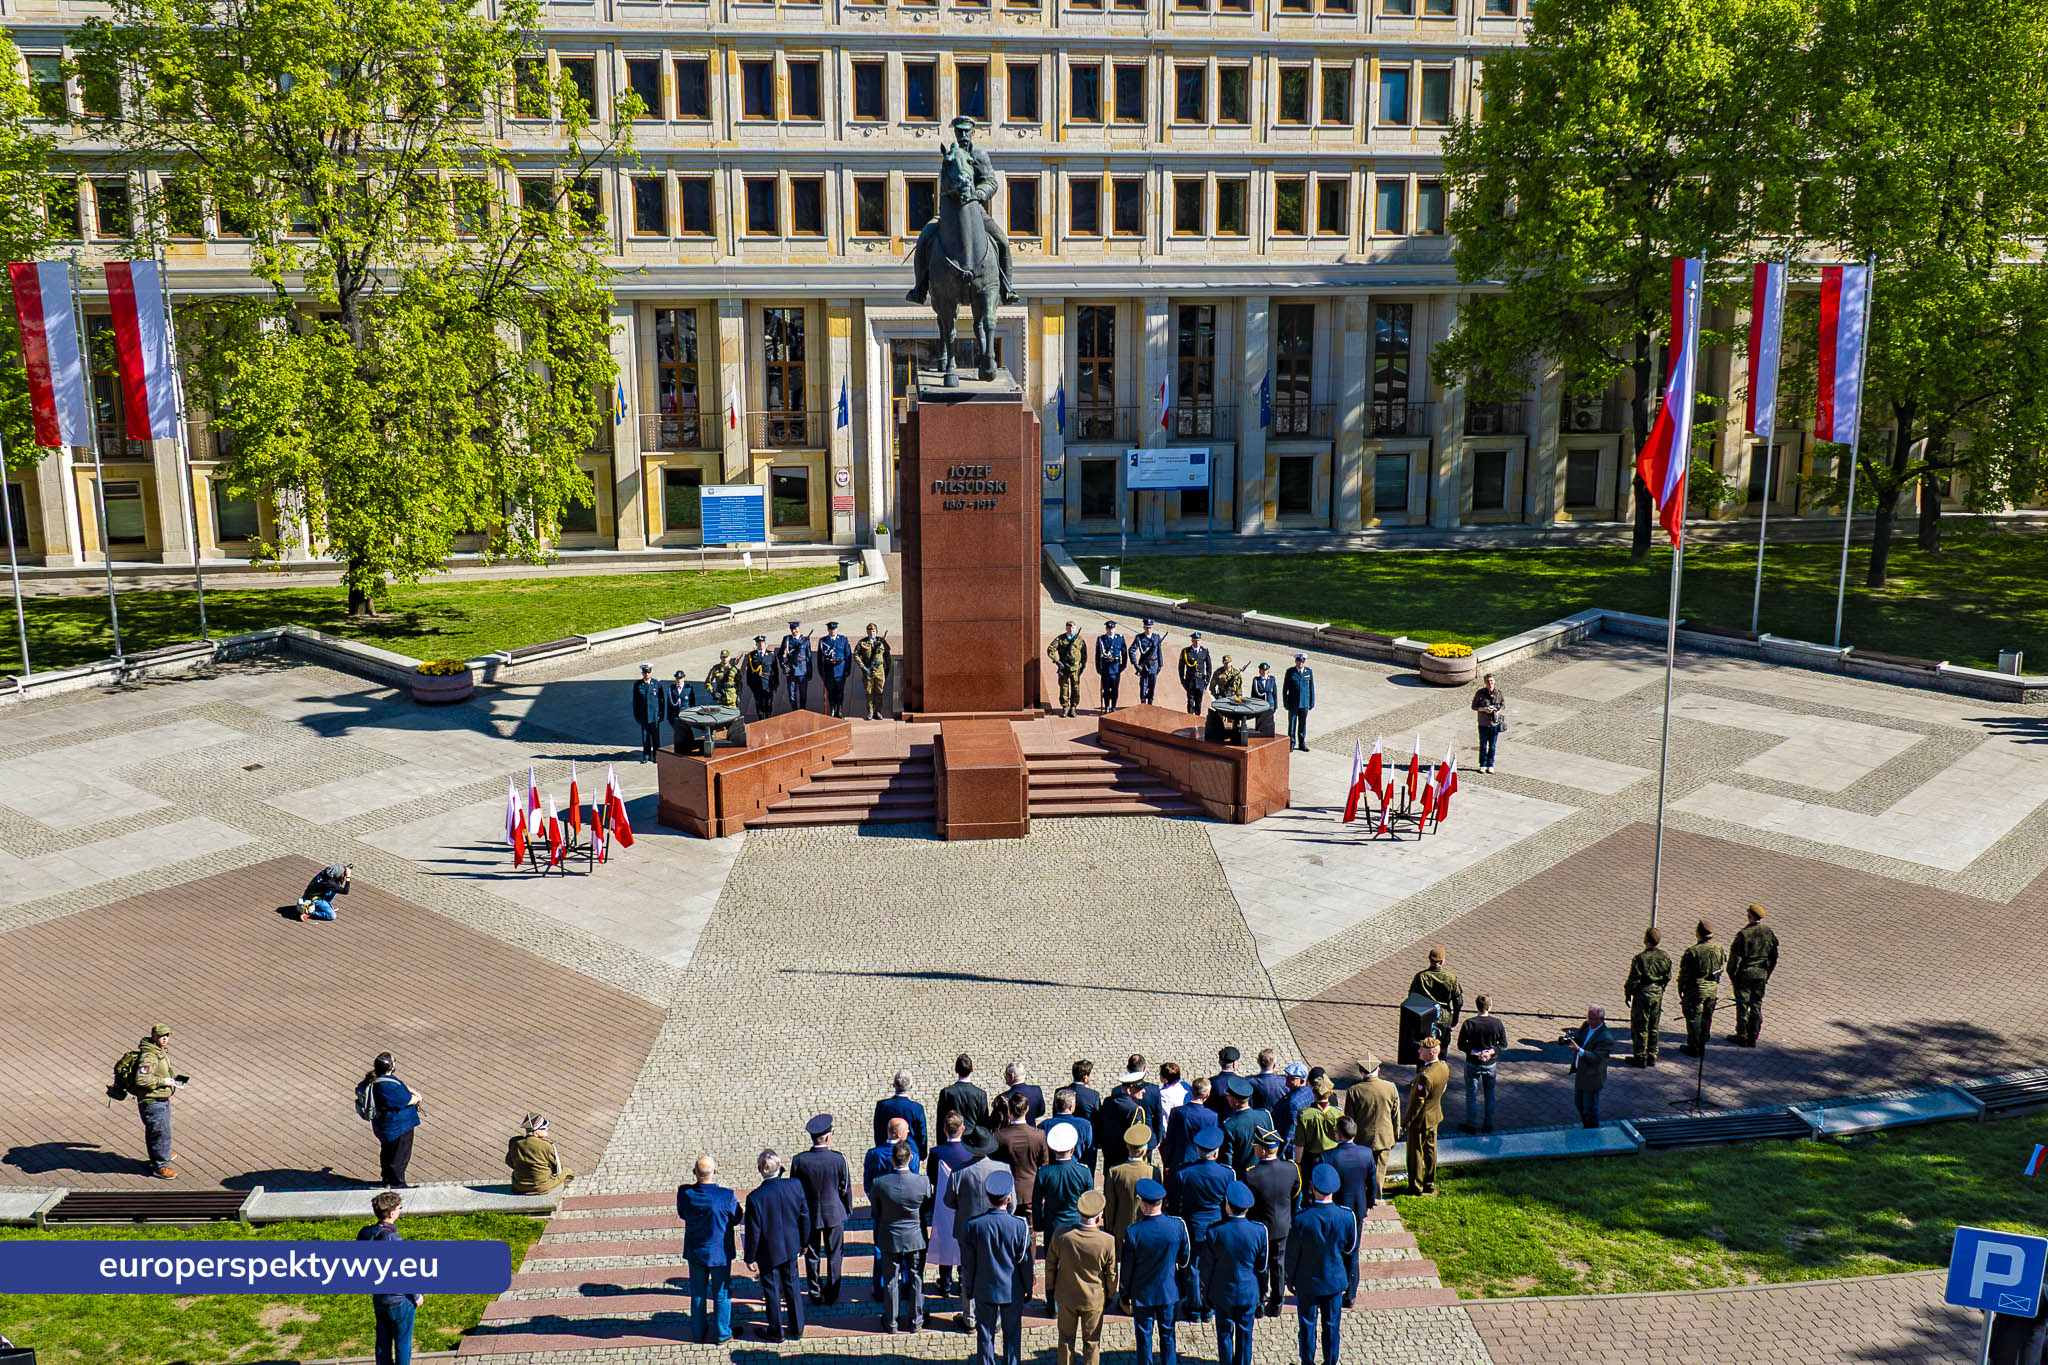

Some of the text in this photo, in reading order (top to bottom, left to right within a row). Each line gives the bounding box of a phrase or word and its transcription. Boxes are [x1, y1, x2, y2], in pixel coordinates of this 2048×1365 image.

[949, 462, 993, 478] JÓZEF
[934, 480, 1009, 493] PIŁSUDSKI
[1969, 1240, 2026, 1299] P
